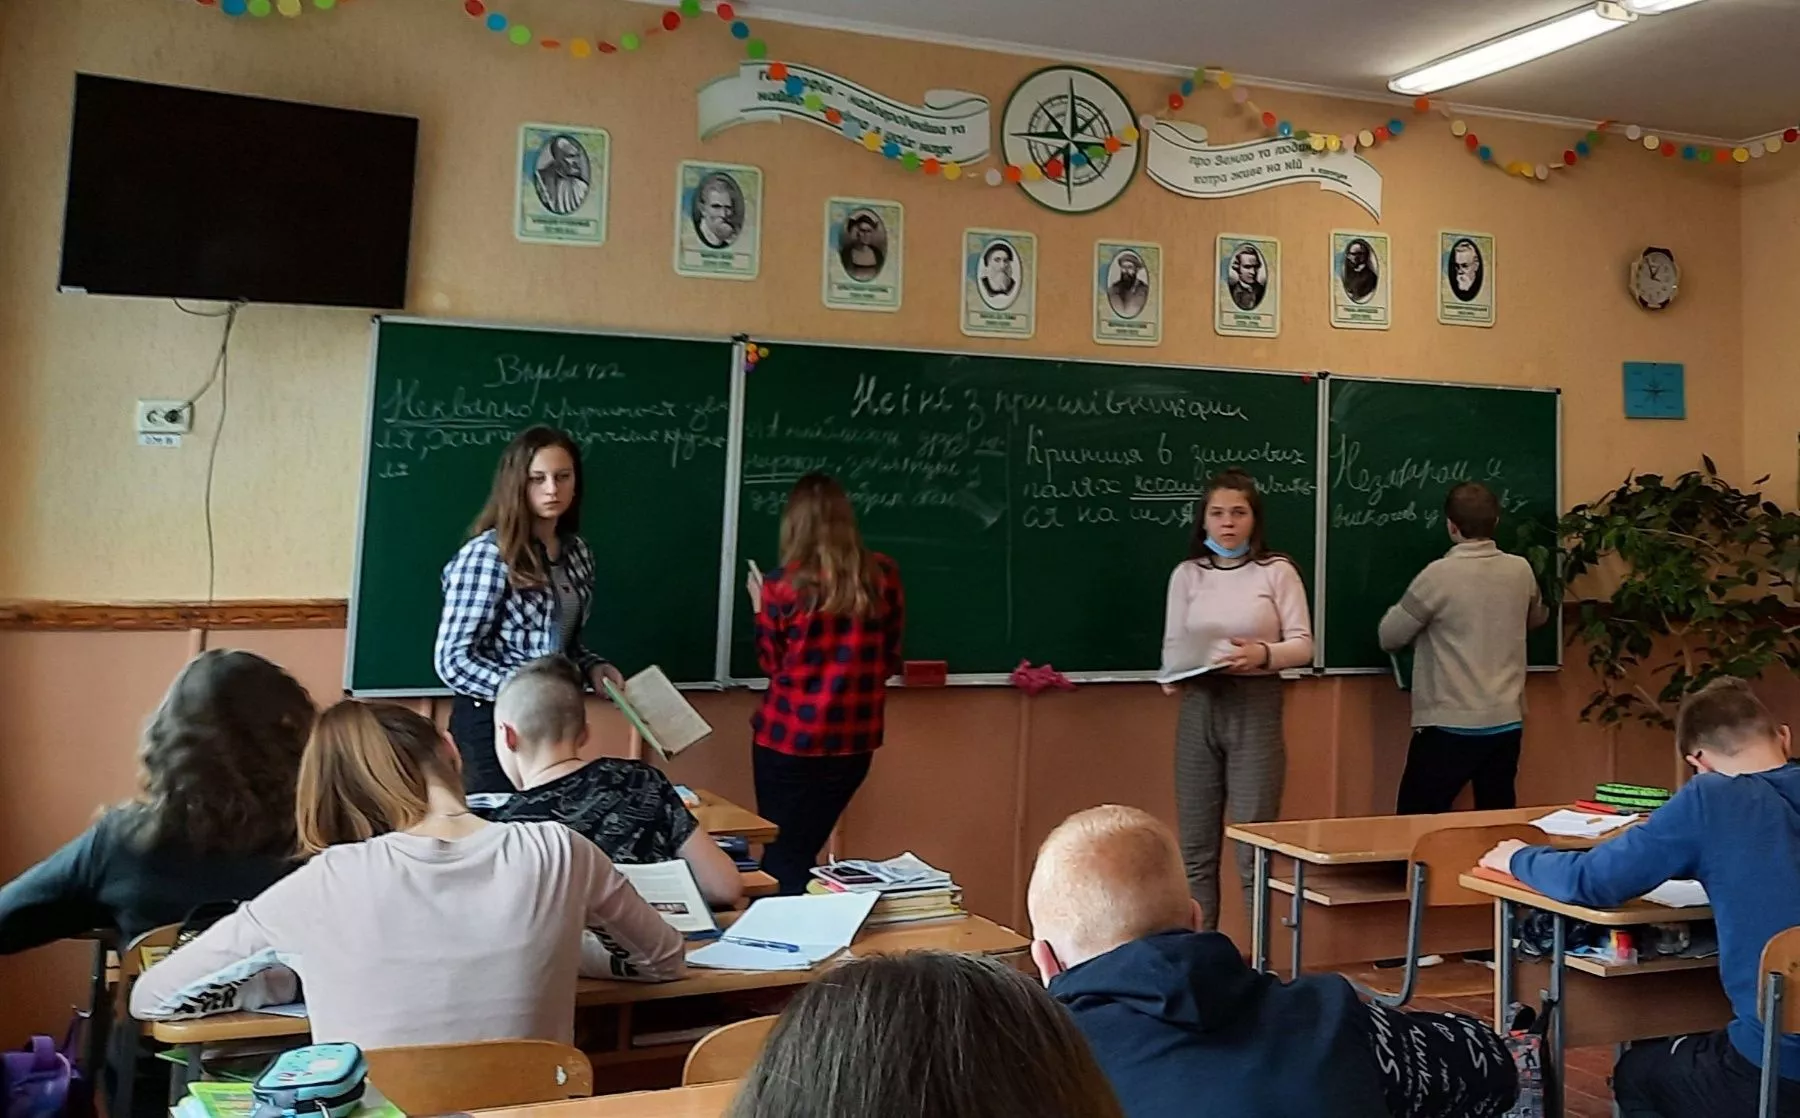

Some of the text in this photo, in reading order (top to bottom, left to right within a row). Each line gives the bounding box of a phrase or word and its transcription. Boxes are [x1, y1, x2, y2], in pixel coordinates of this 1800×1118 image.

[1189, 155, 1211, 168] про
[1258, 148, 1272, 159] та
[1266, 162, 1281, 174] на
[1157, 432, 1173, 465] в
